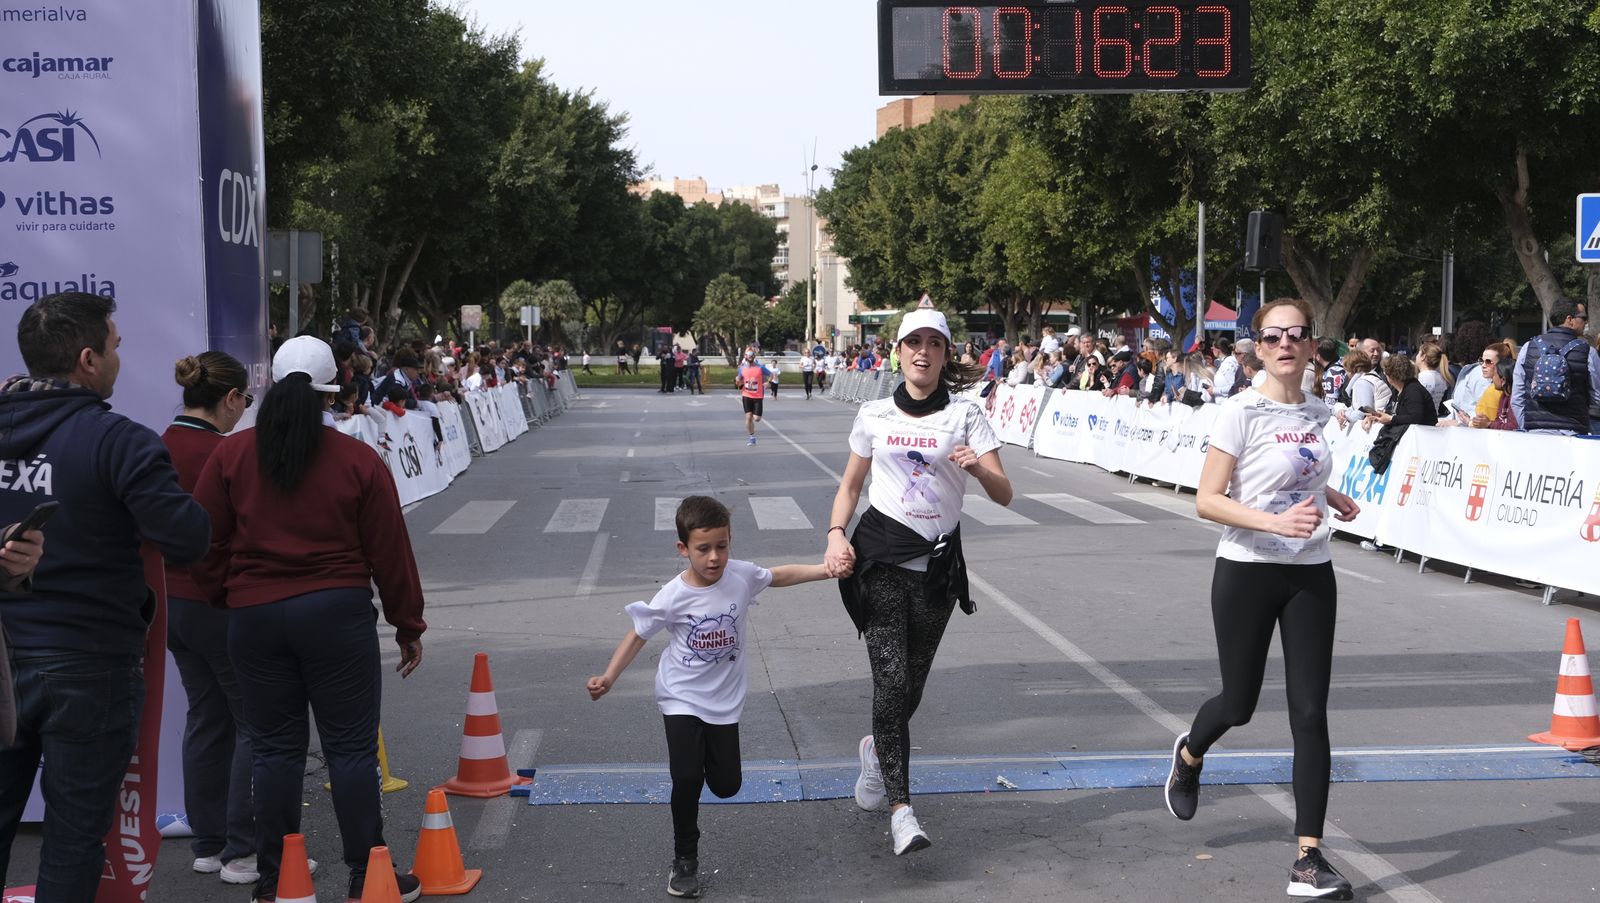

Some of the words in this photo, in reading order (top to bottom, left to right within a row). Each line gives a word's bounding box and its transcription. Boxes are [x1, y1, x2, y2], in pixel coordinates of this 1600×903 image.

[0, 6, 87, 22] merialva
[942, 6, 1231, 79] 00:16:23
[3, 52, 114, 78] cajamar
[58, 72, 80, 80] CAJA
[82, 72, 112, 80] RURAL
[15, 191, 115, 215] vithas
[16, 221, 39, 232] vivir
[42, 223, 67, 233] para
[69, 221, 115, 232] cuidarte
[1, 274, 116, 304] aqualia
[887, 435, 938, 449] MUJER
[1274, 432, 1320, 444] MUJER
[1501, 470, 1584, 509] ALMERÍA
[1497, 503, 1538, 527] CIUDAD
[692, 636, 735, 649] RUNNER
[701, 629, 726, 641] MINI
